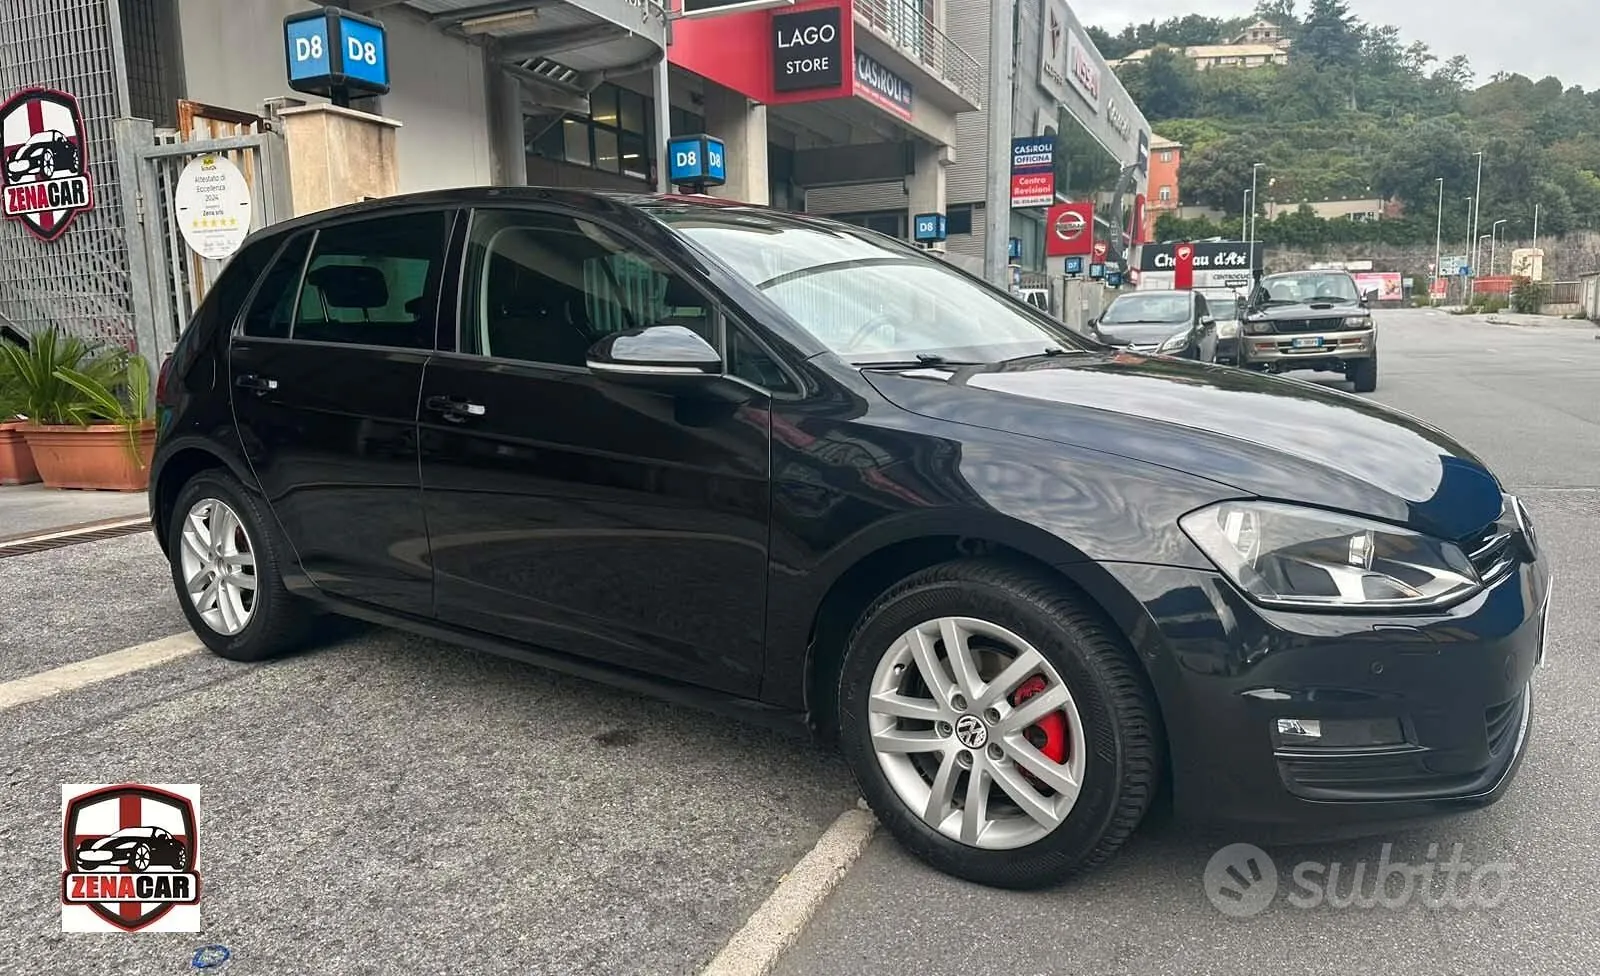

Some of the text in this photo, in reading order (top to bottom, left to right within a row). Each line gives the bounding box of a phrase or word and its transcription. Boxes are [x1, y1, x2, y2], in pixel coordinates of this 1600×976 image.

[777, 24, 836, 49] LAGO
[296, 35, 323, 62] D8
[348, 36, 377, 66] D8
[786, 57, 829, 74] STORE
[676, 151, 697, 167] D8
[709, 151, 721, 168] D8
[1016, 155, 1050, 164] OFFICINA
[1019, 177, 1047, 186] Centro
[8, 177, 86, 214] ZENACAR
[1014, 187, 1051, 196] Revisioni
[919, 222, 934, 232] D8
